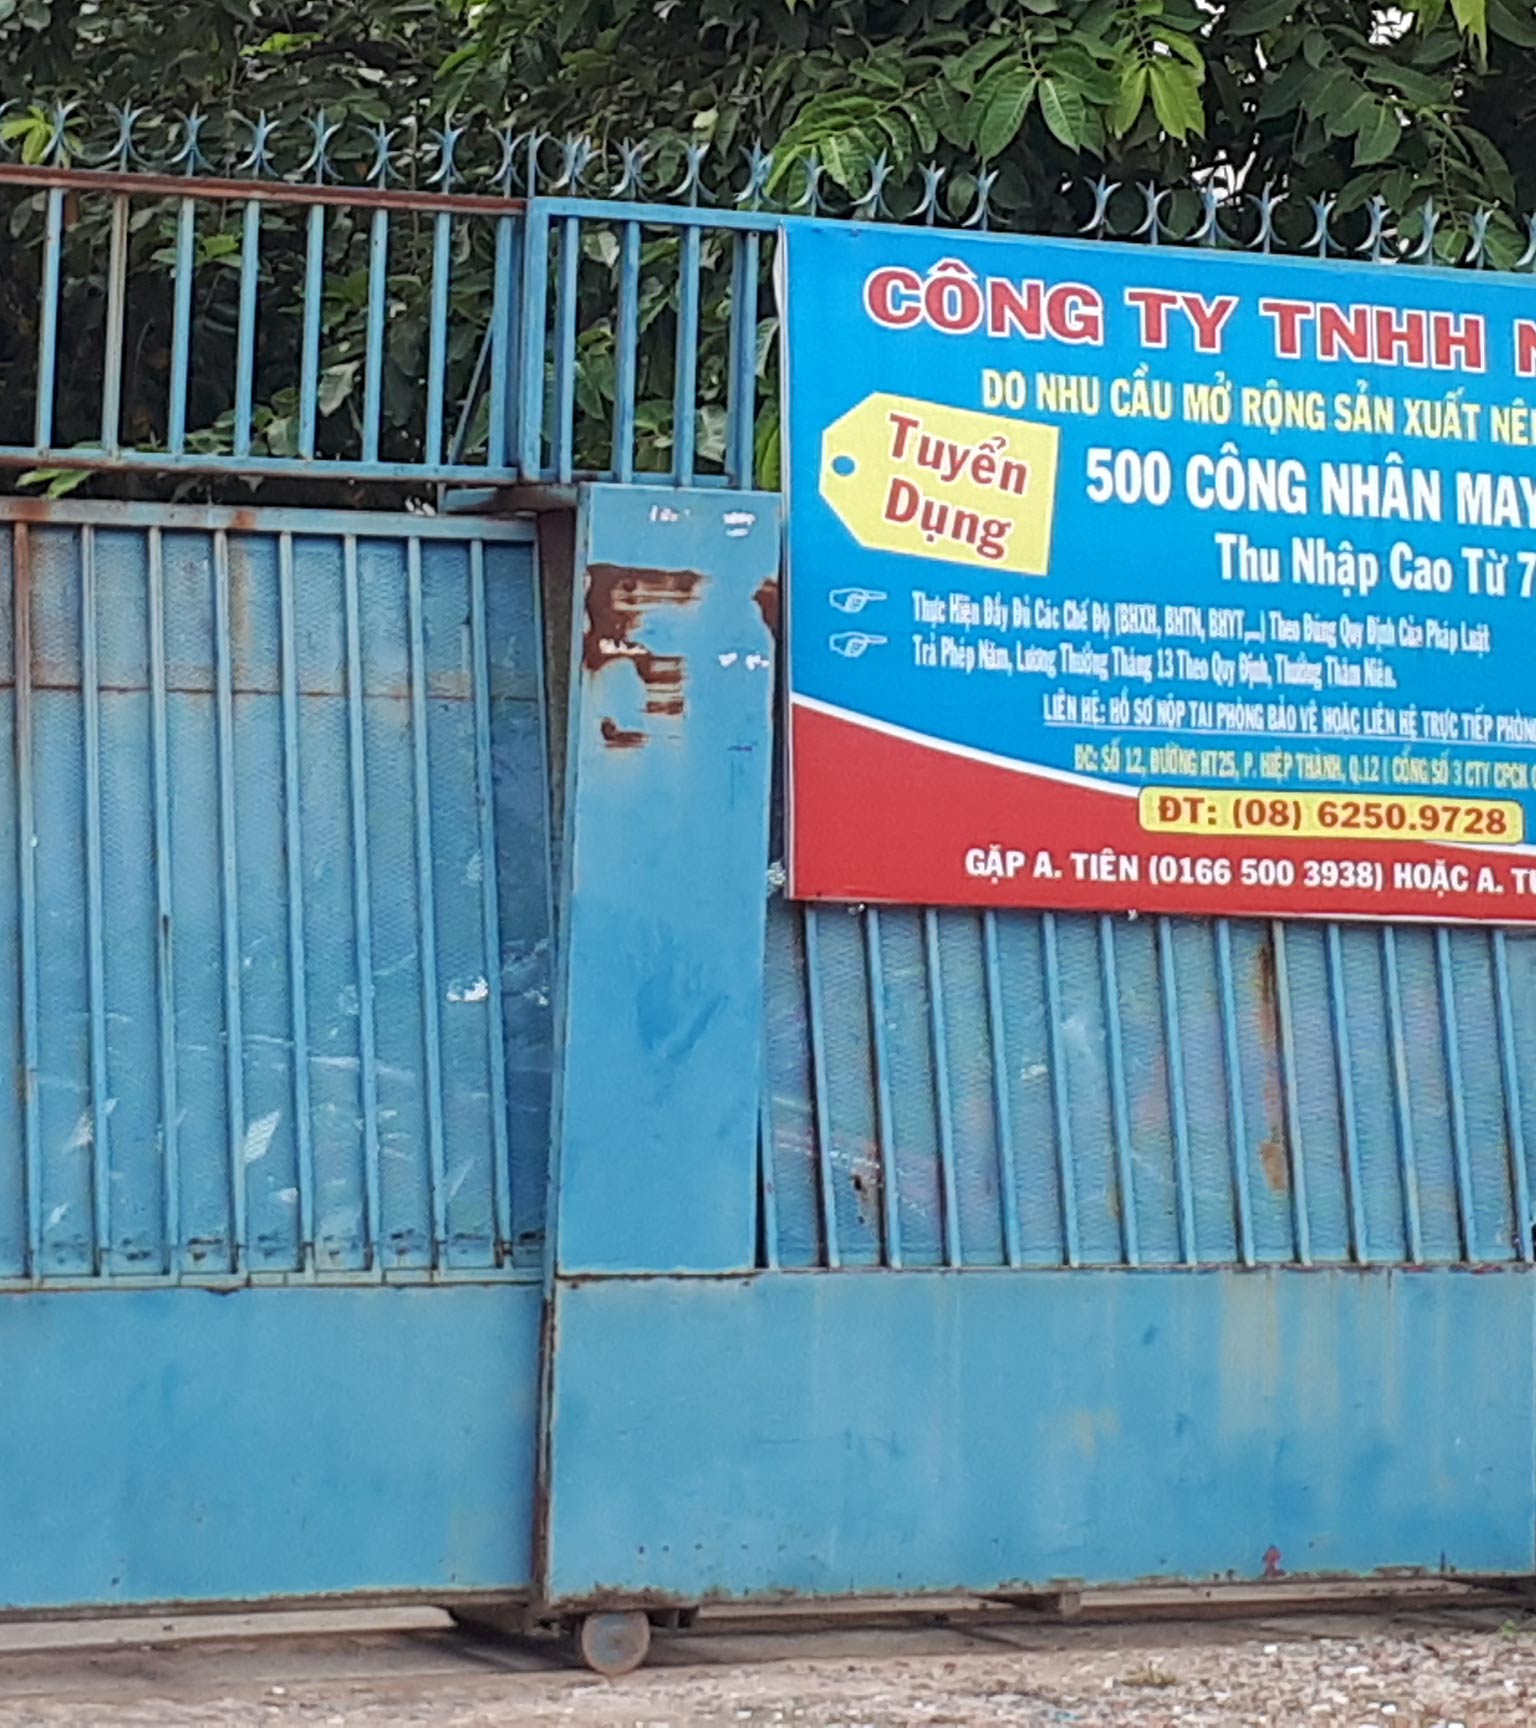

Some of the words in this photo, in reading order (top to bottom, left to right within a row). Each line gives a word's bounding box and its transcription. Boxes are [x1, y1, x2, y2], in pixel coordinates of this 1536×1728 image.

[865, 257, 1104, 345] CÔNG
[1123, 287, 1239, 354] TY
[1259, 298, 1487, 373] TNHH
[981, 369, 1026, 410] DO
[1037, 373, 1099, 416] NHU
[1110, 363, 1173, 419] CẦU
[1183, 372, 1233, 424] MỞ
[1242, 377, 1326, 438] RỘNG
[1334, 379, 1394, 435] SẢN
[1403, 387, 1481, 442] XUẤT
[885, 412, 1032, 496] Tuyển
[1085, 447, 1170, 505] 500
[1186, 443, 1308, 515] CÔNG
[1322, 451, 1441, 522] NHÂN
[882, 476, 1015, 562] Dụng
[1215, 533, 1280, 583] Thu
[1290, 537, 1380, 597] Nhập
[1389, 540, 1452, 594] Cao
[1461, 547, 1508, 598] Từ
[1157, 795, 1218, 826] ĐT:
[1233, 798, 1302, 831] (08)
[1317, 800, 1508, 835] 6250.9728
[965, 844, 1024, 885] GẶP
[1033, 851, 1063, 879] A.
[1070, 847, 1140, 883] TIÊN
[1149, 856, 1232, 886] (0166
[1240, 858, 1294, 887] 500
[1303, 860, 1384, 892] 3938)
[1394, 859, 1470, 899] HOẶC
[1476, 868, 1505, 895] A.
